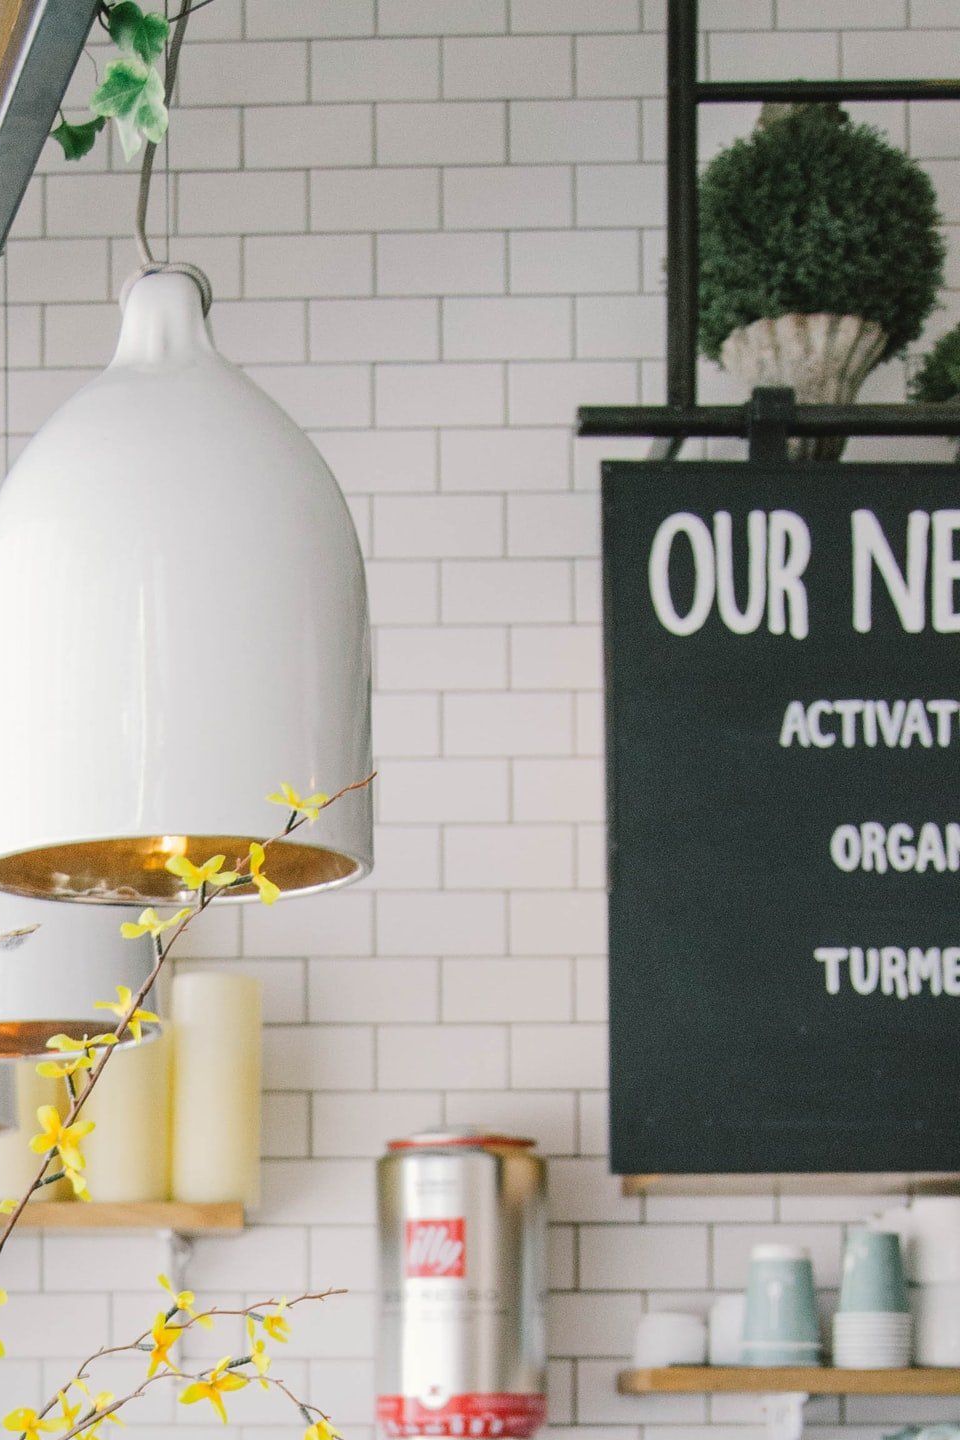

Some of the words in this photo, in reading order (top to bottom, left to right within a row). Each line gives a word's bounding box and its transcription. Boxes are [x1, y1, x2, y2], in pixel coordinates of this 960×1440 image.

[648, 509, 812, 640] OUR
[850, 508, 960, 634] NE
[778, 698, 960, 749] ACTIVAT
[409, 1224, 463, 1274] illy
